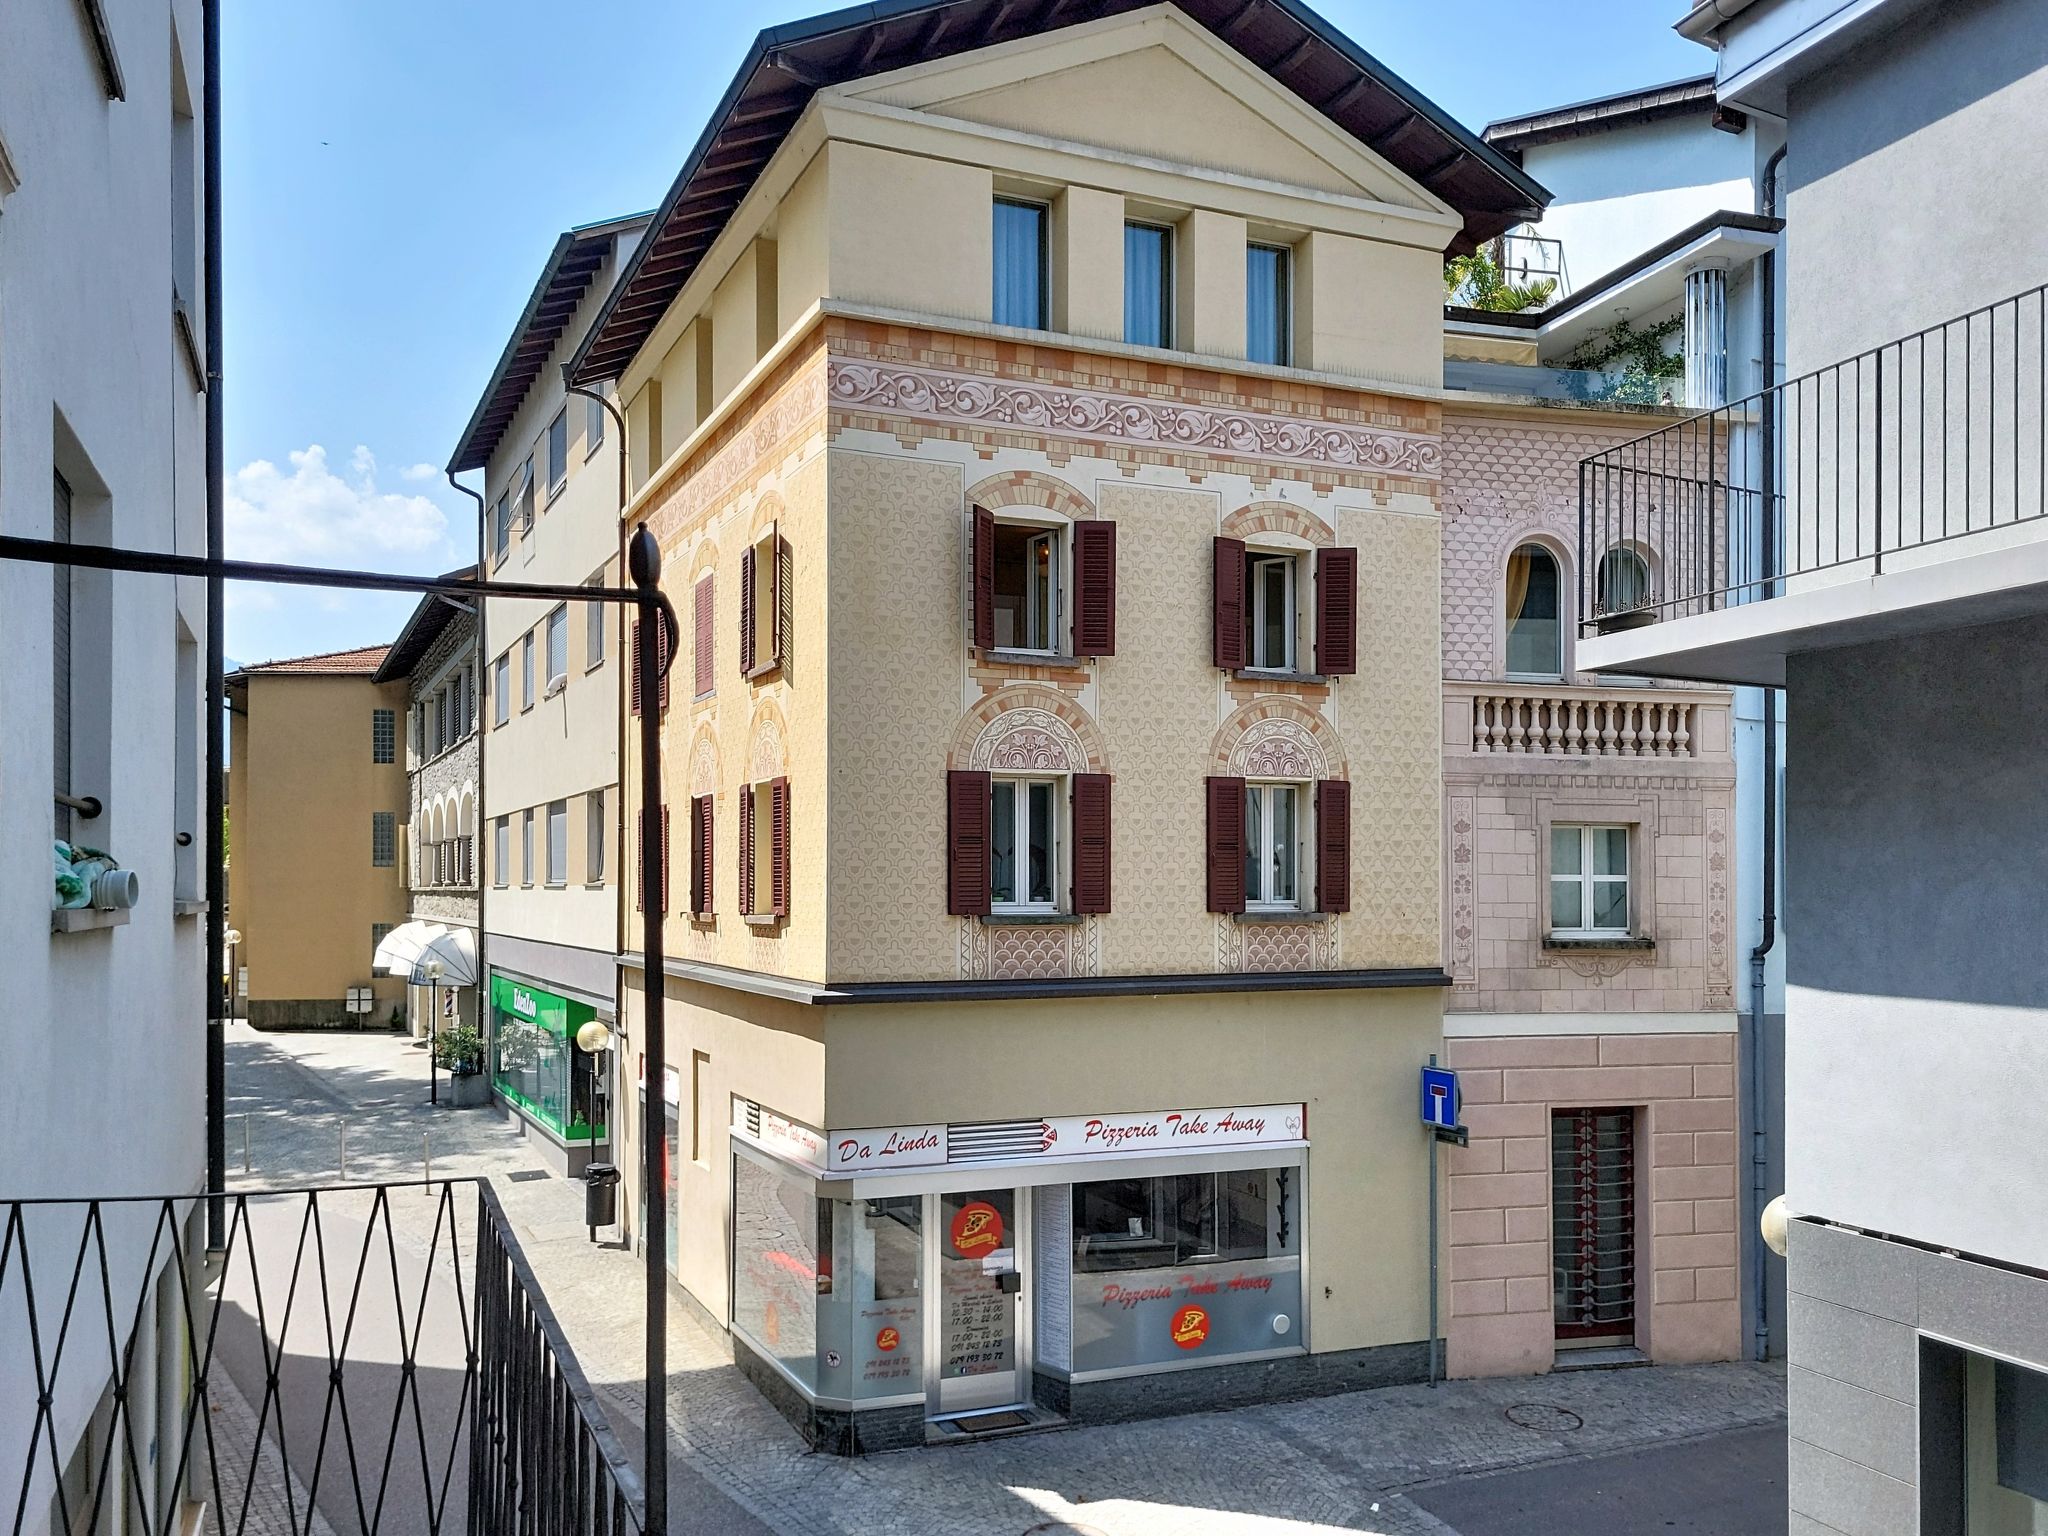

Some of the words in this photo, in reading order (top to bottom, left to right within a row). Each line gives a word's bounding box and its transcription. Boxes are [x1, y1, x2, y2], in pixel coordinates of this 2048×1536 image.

[513, 987, 536, 1018] EdenZoo
[1085, 1119, 1159, 1147] Pizzeria
[1166, 1114, 1209, 1137] Take
[1213, 1111, 1266, 1136] Away
[838, 1139, 872, 1163] Da
[879, 1130, 940, 1155] Linda
[1101, 1284, 1173, 1310] Pizzeria
[1177, 1274, 1220, 1298] Take
[1224, 1272, 1273, 1294] Away
